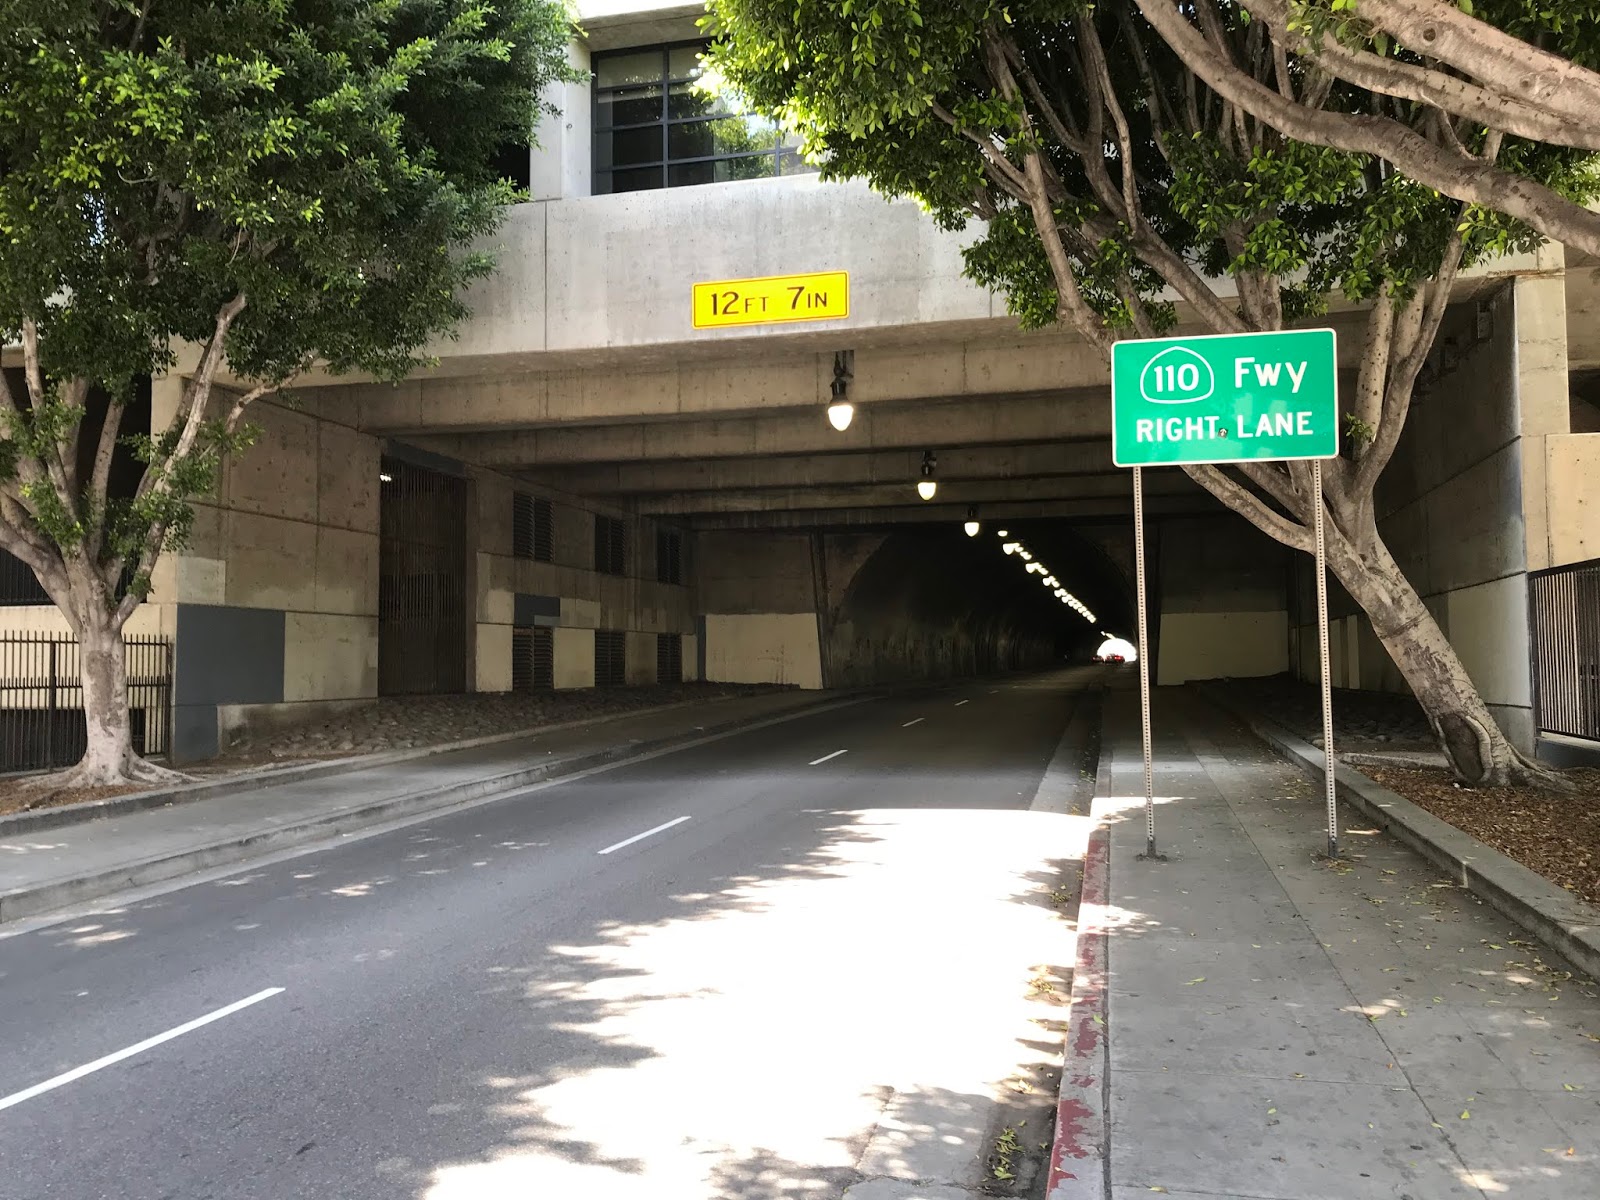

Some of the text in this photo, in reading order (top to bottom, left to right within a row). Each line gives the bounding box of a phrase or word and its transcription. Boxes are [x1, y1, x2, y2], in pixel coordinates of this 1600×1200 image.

[1153, 357, 1307, 394] 110 Fwy
[1136, 411, 1313, 443] RIGHT LANE
